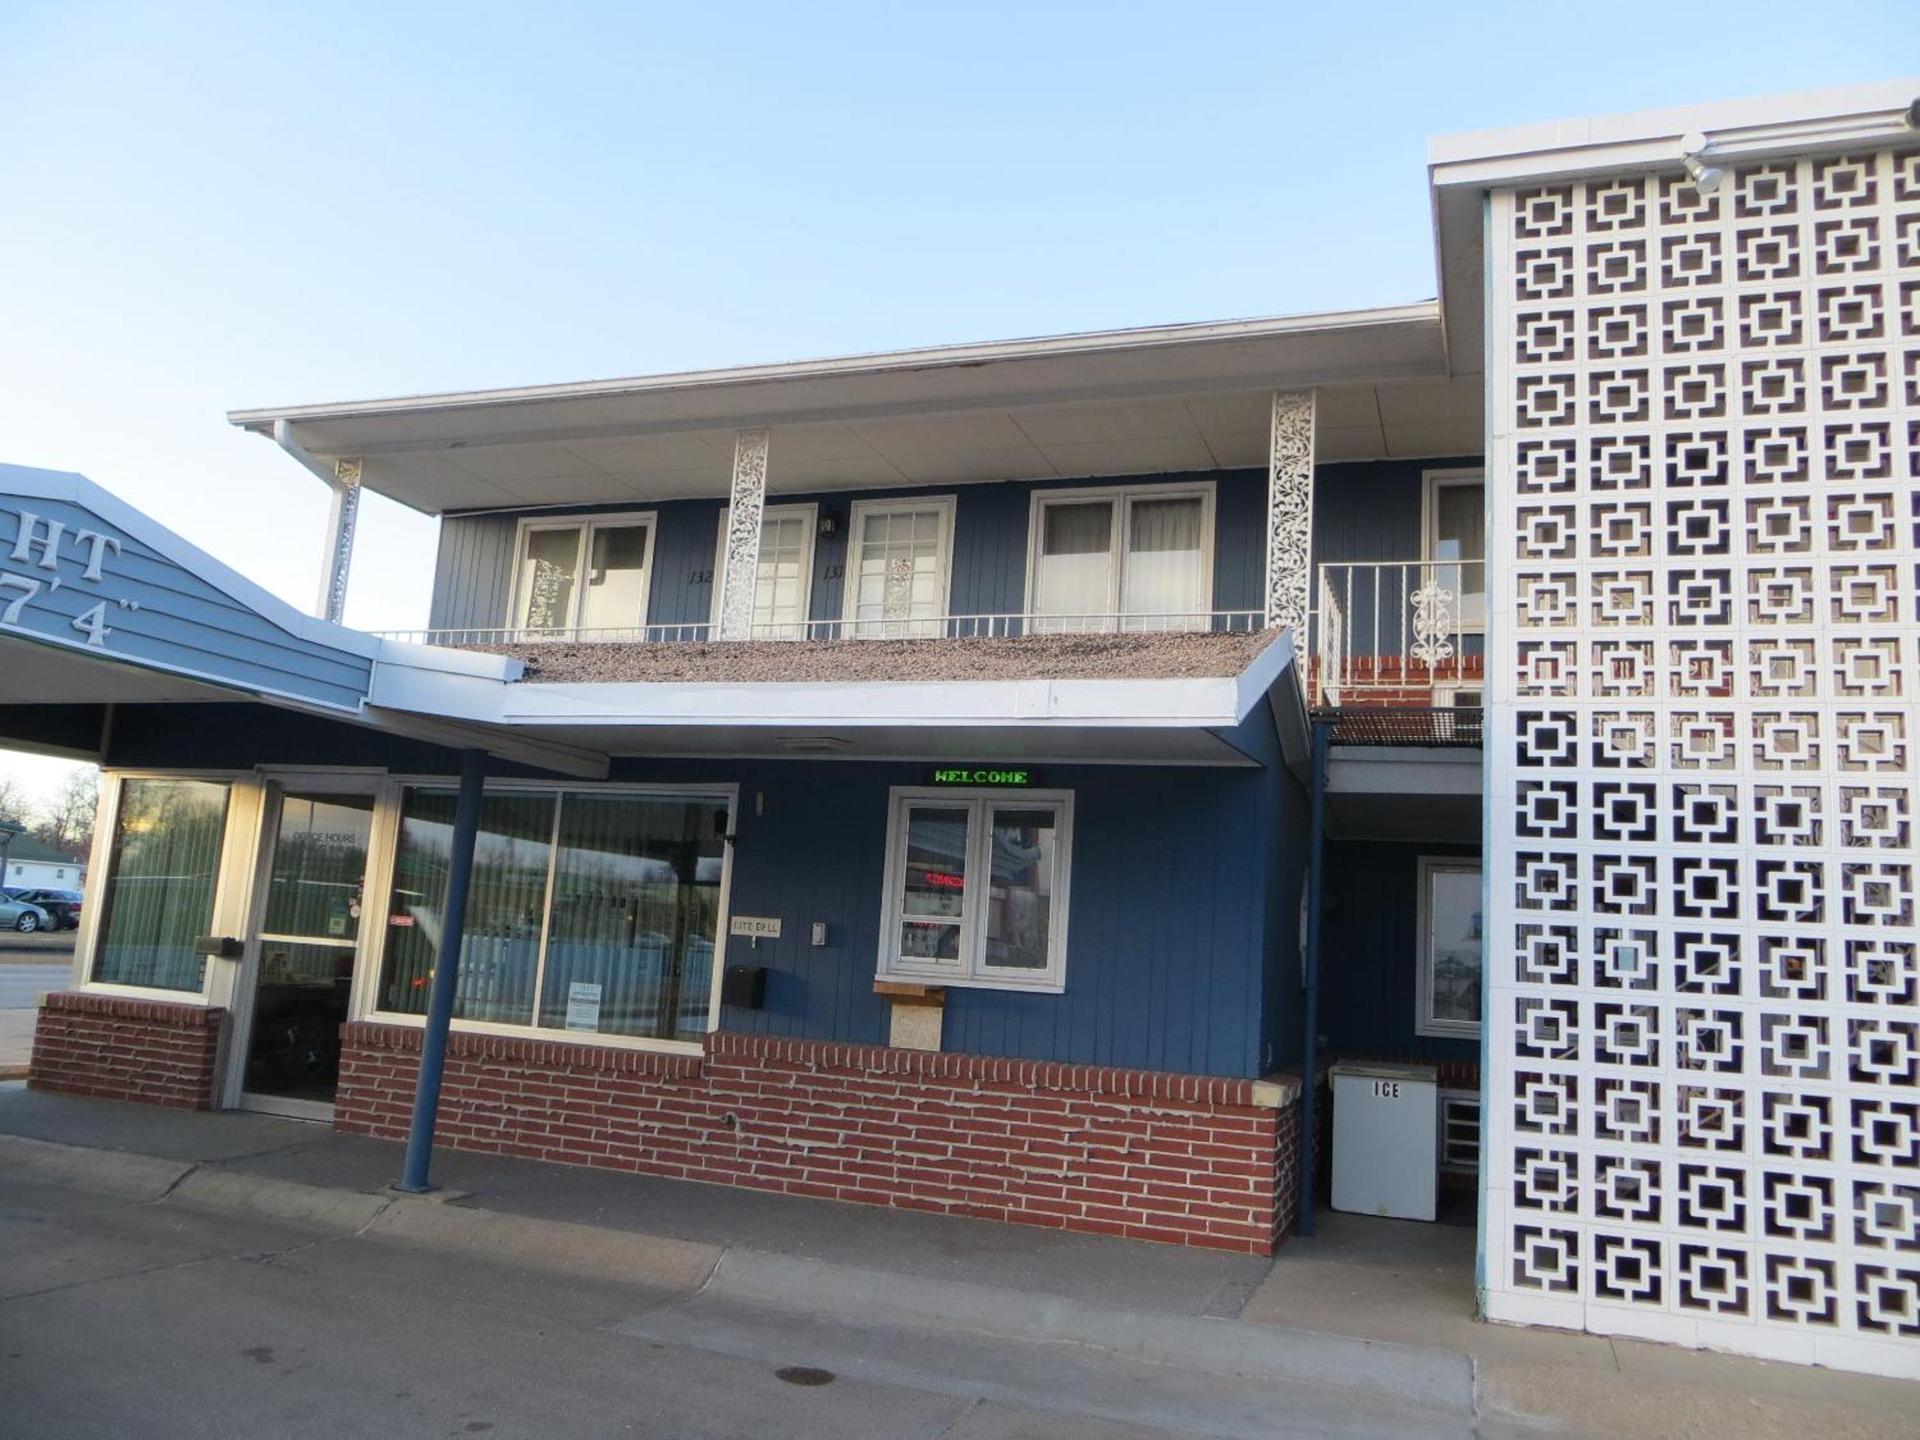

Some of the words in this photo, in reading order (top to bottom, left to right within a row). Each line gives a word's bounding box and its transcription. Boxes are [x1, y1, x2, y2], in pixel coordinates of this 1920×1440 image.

[9, 510, 122, 581] HT
[689, 571, 714, 585] 132
[823, 565, 844, 581] 131
[934, 770, 1028, 784] WELCOME
[1374, 1080, 1399, 1098] ICE
